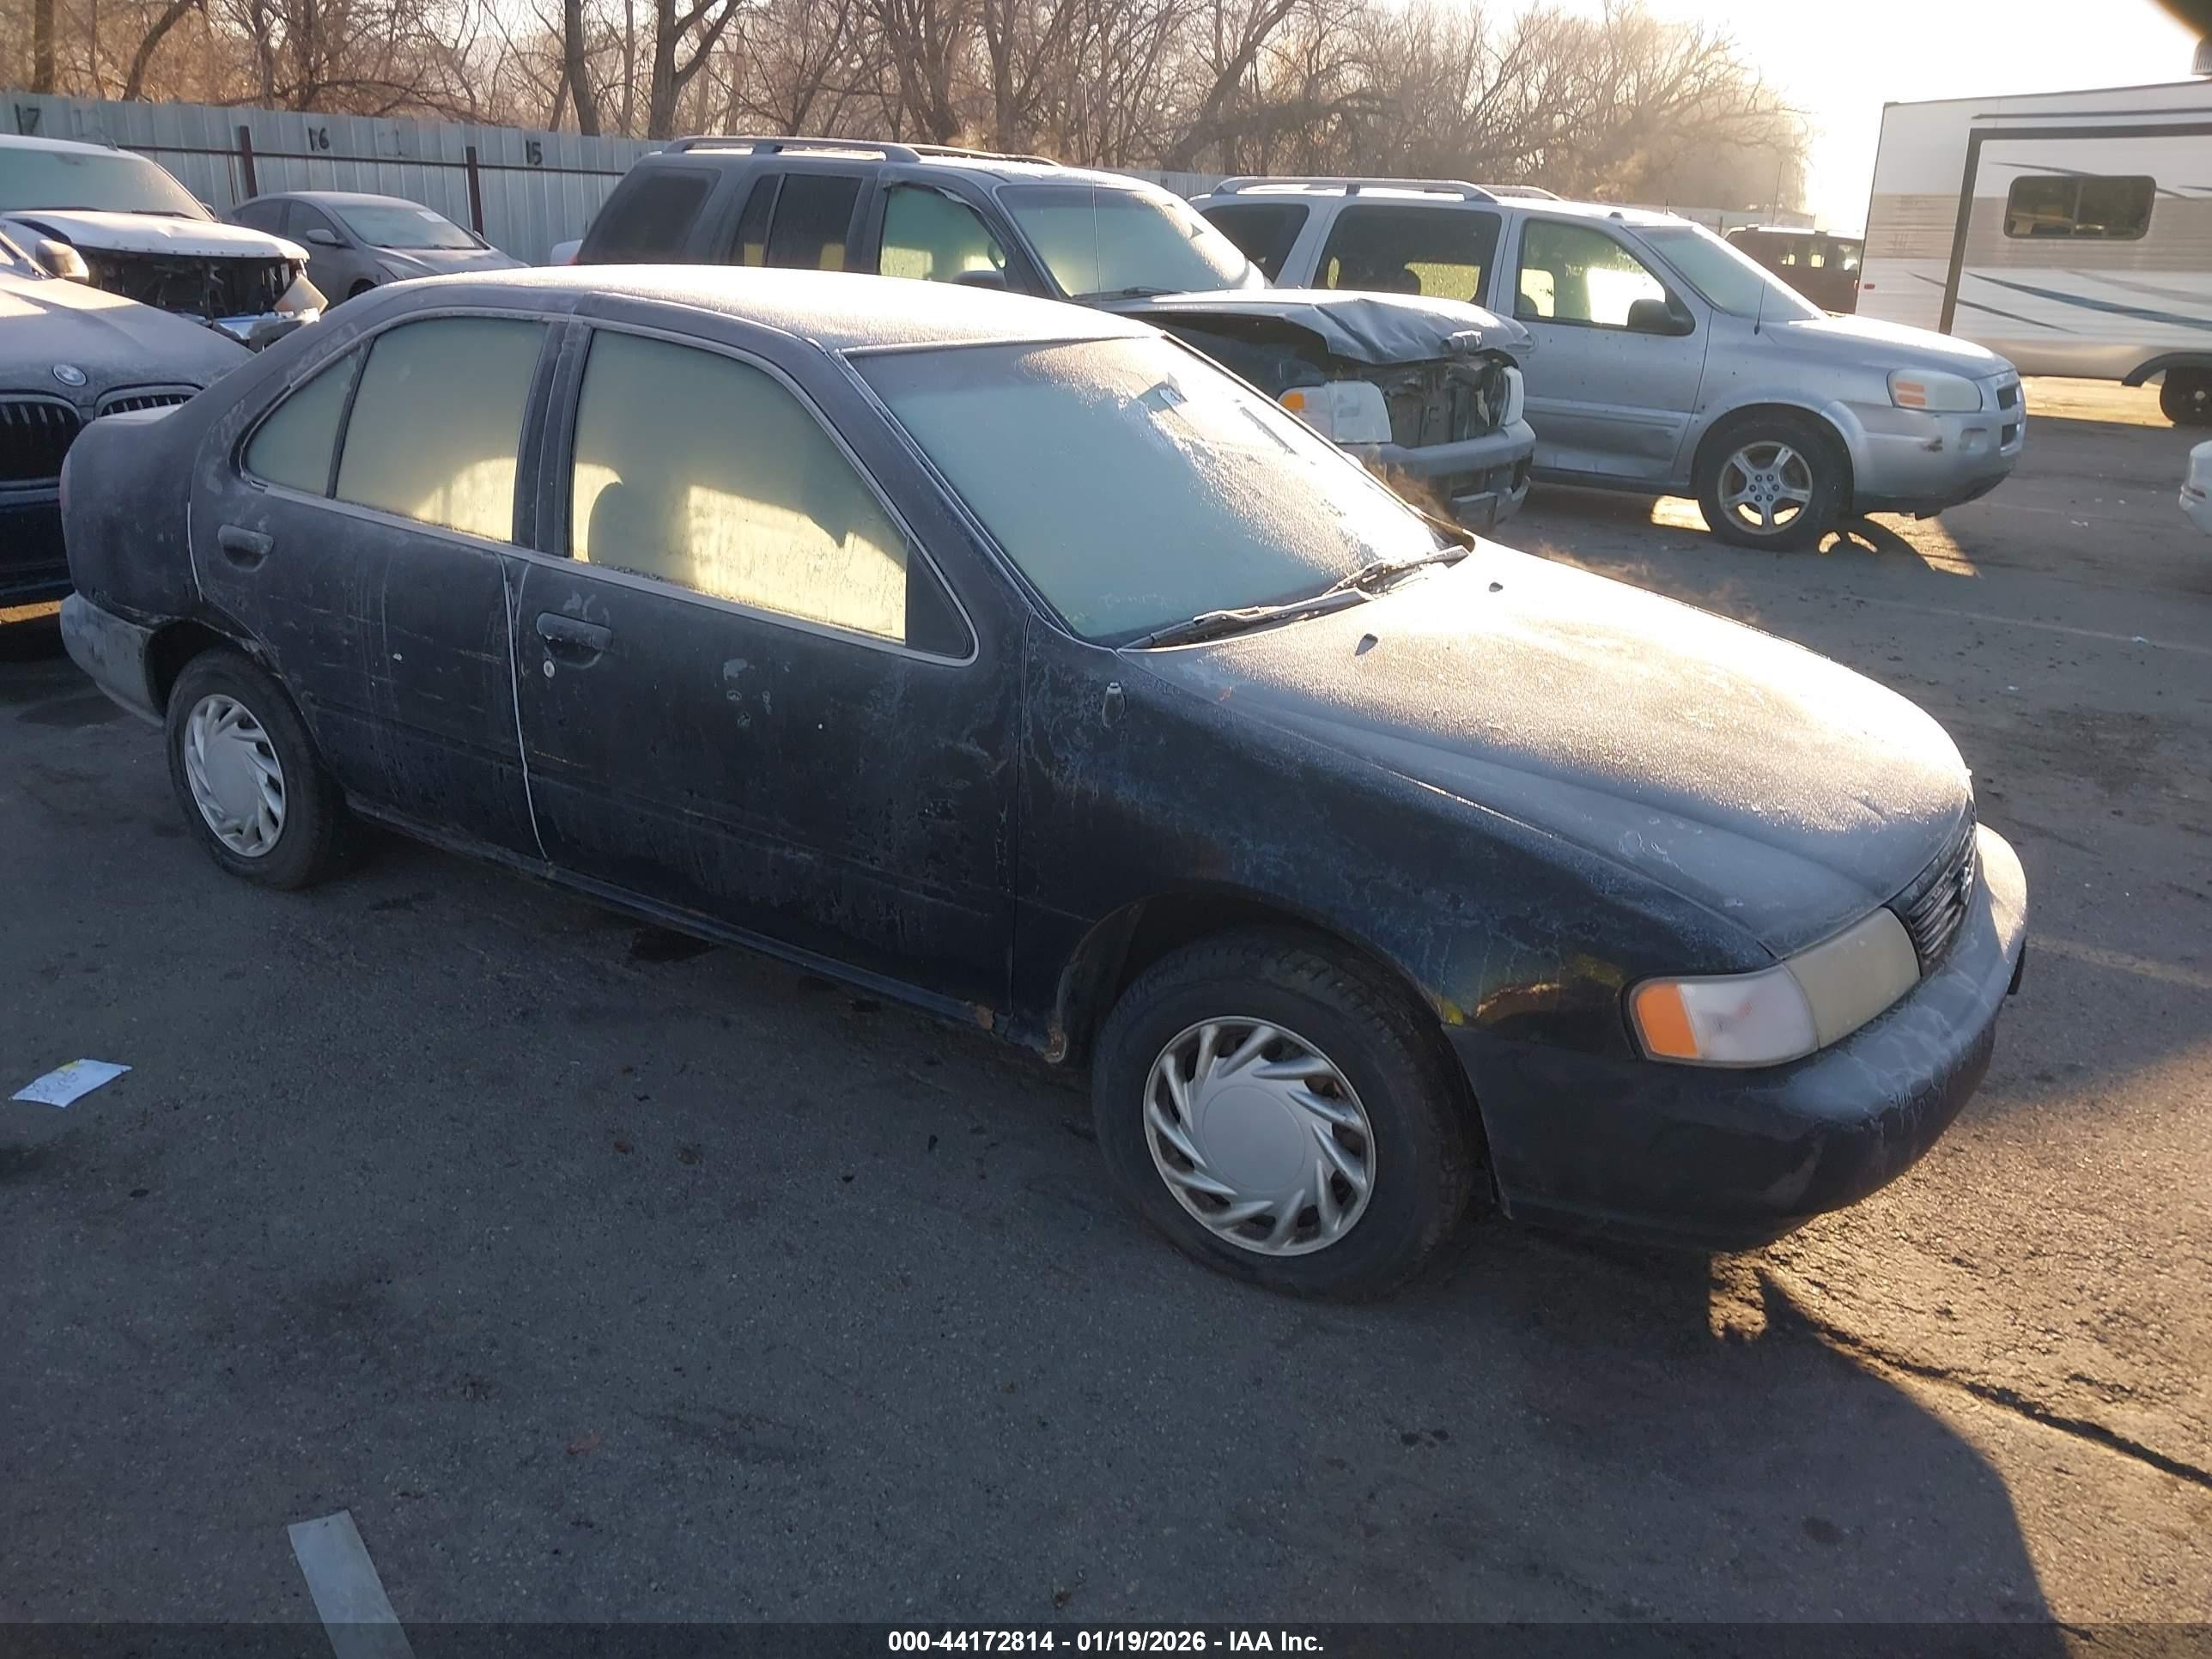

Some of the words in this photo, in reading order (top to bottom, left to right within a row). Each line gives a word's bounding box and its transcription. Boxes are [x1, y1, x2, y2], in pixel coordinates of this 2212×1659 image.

[14, 102, 42, 136] 17
[307, 126, 331, 152] 16
[525, 139, 544, 167] 15
